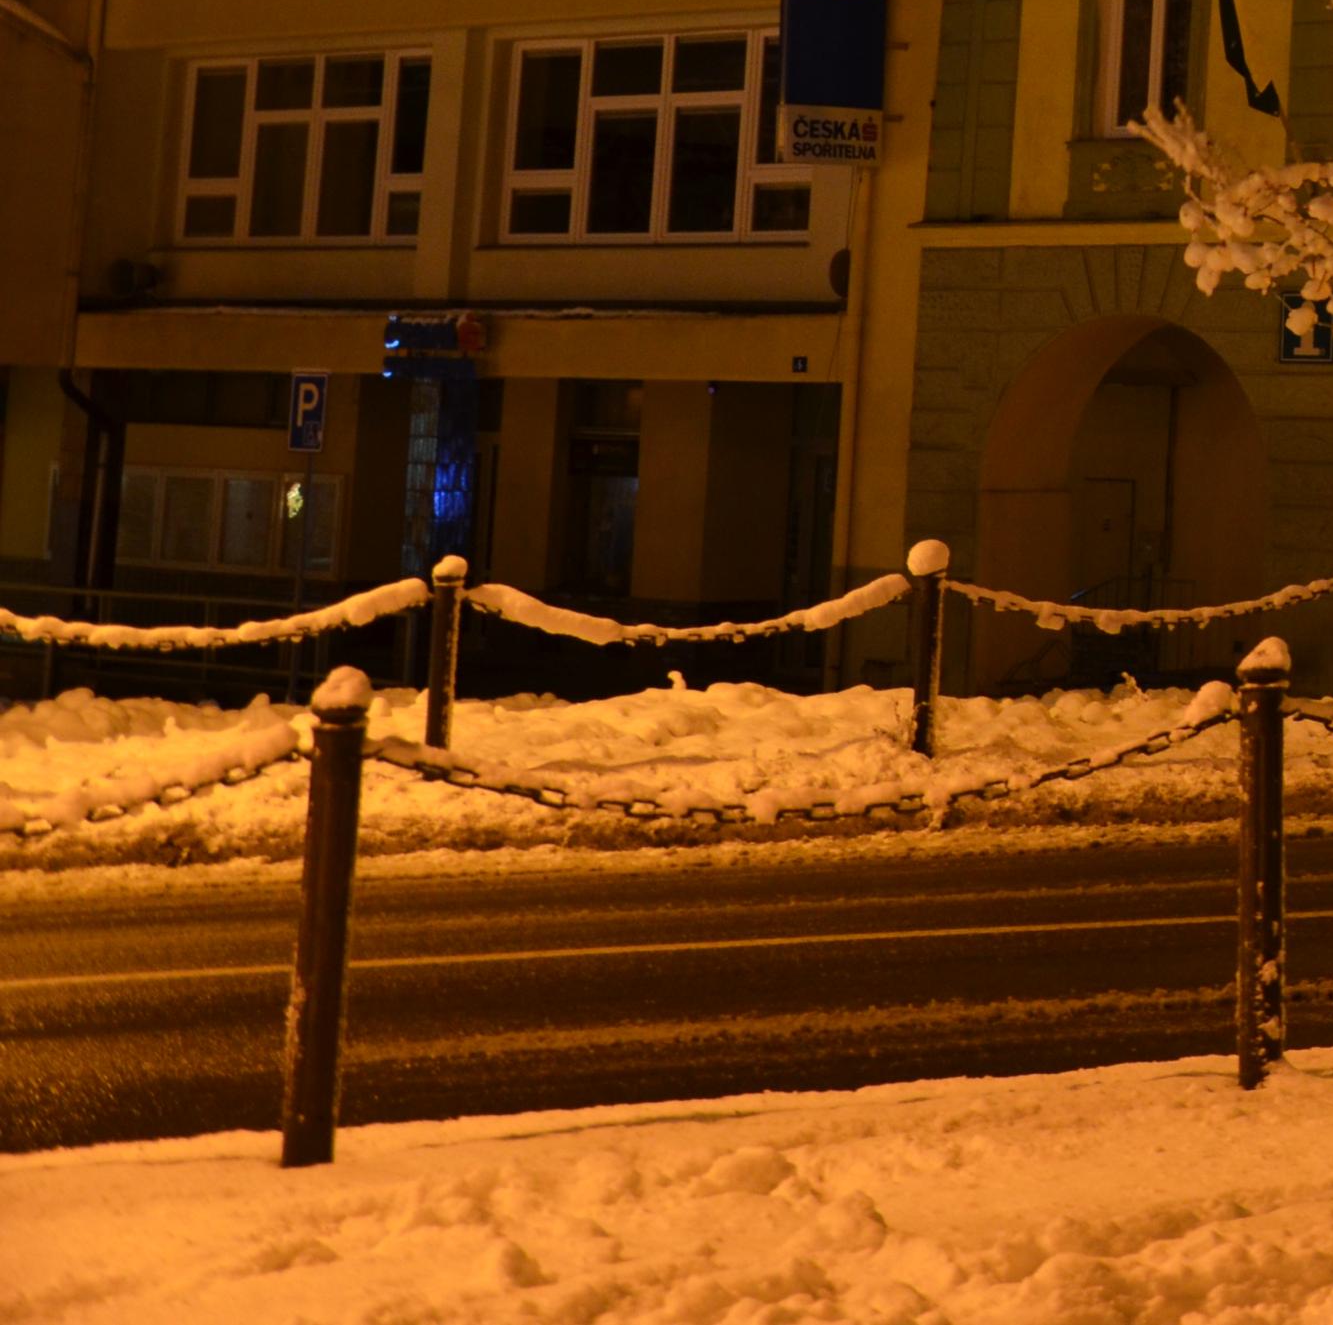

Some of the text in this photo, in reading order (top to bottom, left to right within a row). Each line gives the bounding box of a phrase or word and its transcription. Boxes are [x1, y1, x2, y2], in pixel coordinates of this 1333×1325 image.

[793, 114, 861, 141] ČESKÁ
[793, 140, 876, 160] SPOŘITELNA
[296, 382, 320, 428] P
